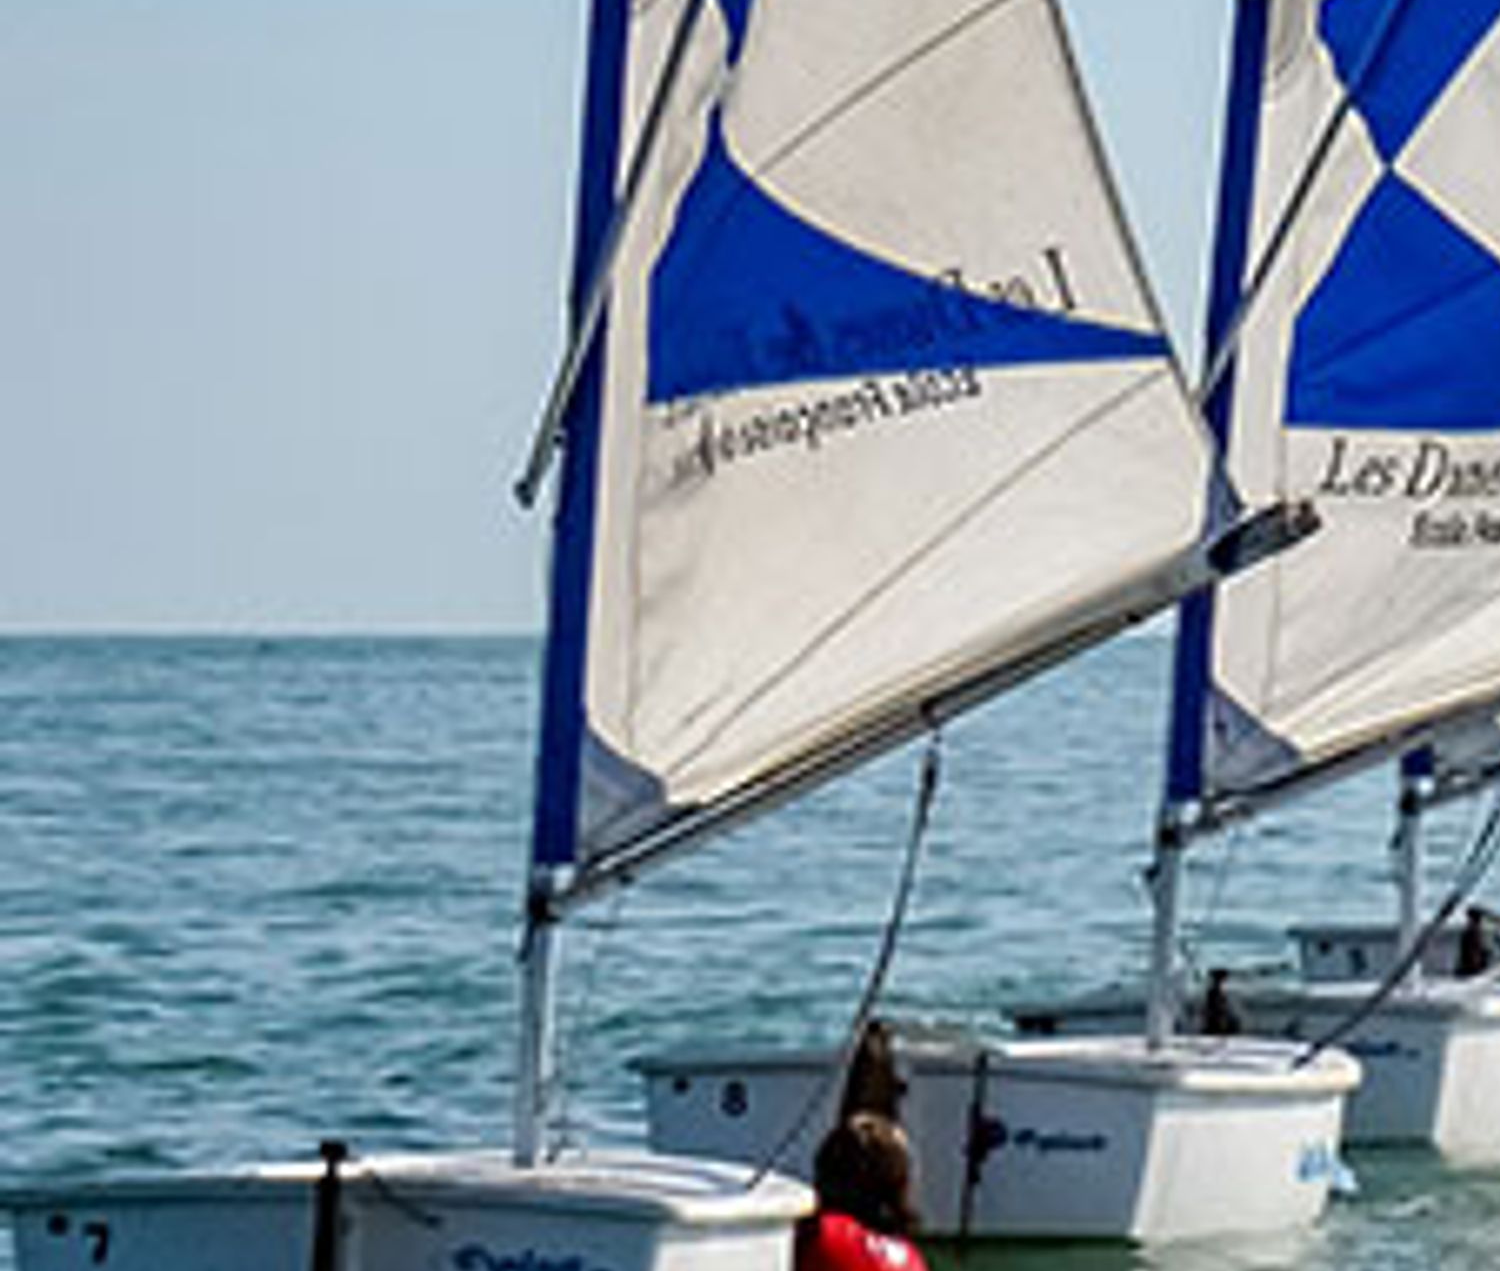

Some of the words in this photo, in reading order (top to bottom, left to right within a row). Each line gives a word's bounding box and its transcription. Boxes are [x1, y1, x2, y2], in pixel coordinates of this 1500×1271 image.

[1320, 438, 1398, 496] Les
[721, 1080, 748, 1119] 8
[82, 1221, 109, 1267] 7
